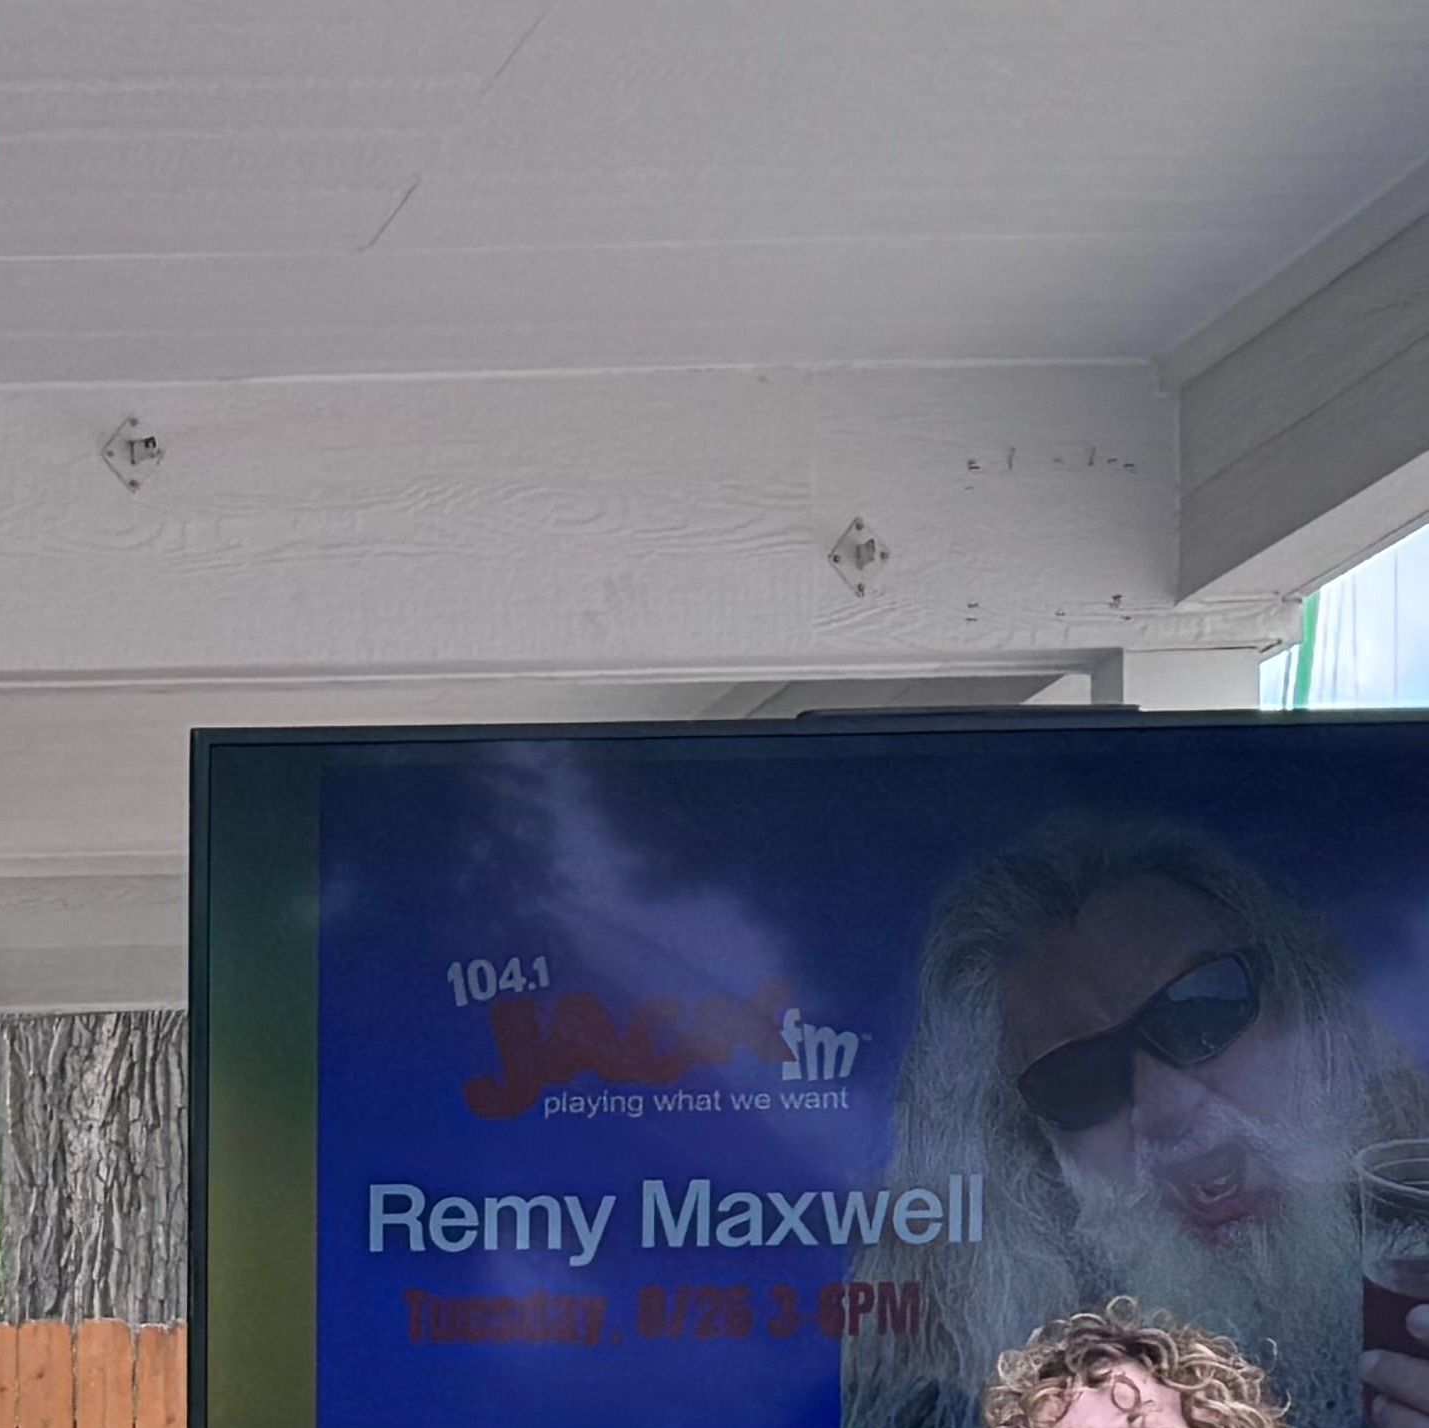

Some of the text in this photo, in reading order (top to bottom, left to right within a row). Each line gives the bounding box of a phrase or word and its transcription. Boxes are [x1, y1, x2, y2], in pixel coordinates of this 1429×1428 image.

[448, 956, 550, 1007] 104.1
[544, 1086, 849, 1118] playing what we want
[369, 1173, 983, 1267] Remy Maxwell
